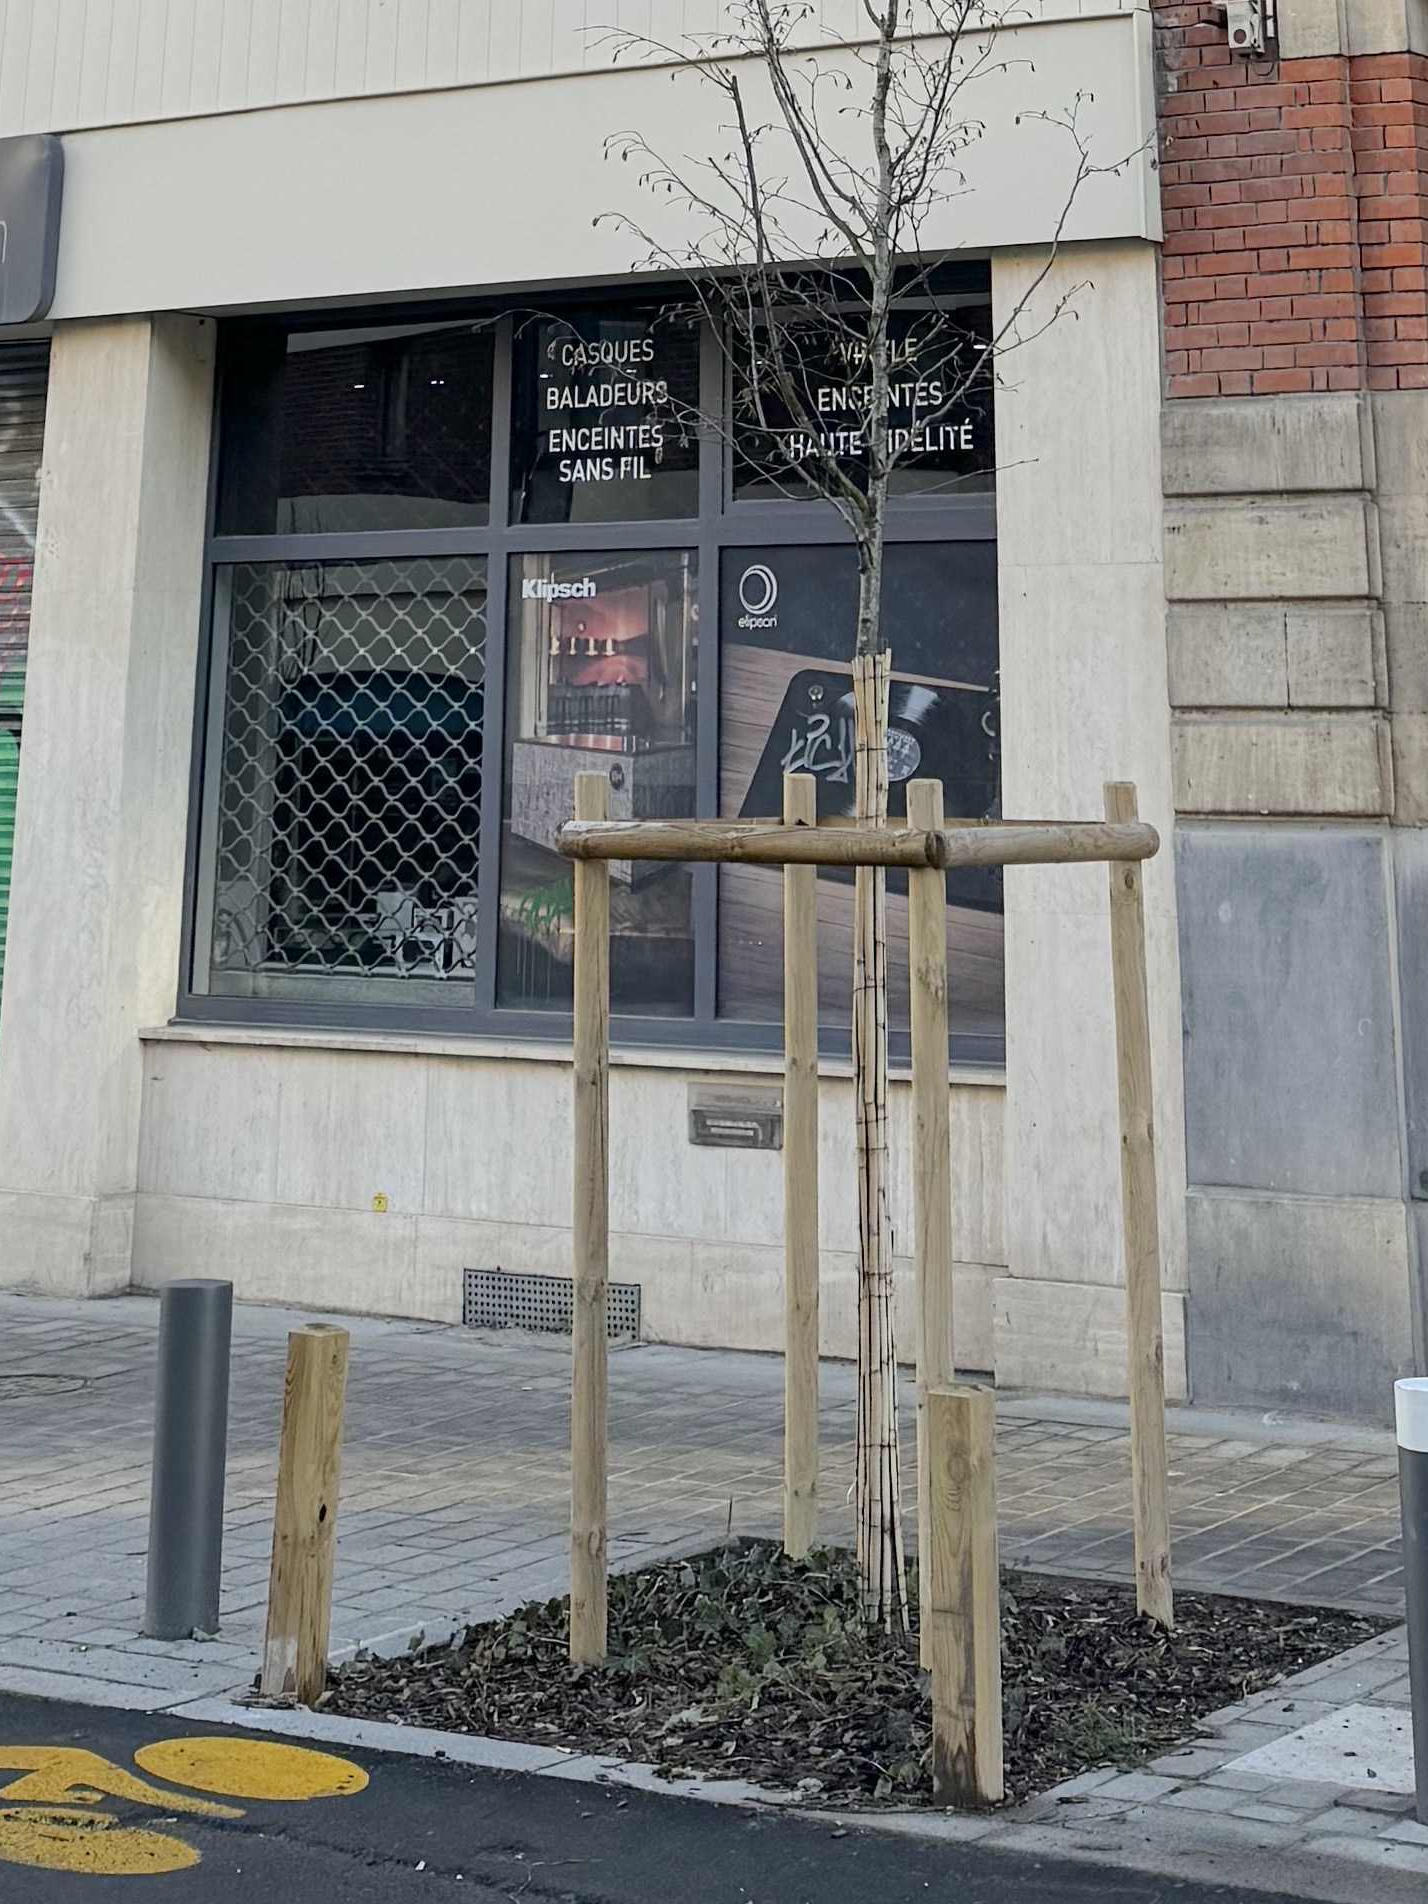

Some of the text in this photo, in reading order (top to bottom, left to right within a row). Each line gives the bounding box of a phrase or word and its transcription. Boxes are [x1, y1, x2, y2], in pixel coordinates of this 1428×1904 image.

[562, 338, 654, 366] CASQUES
[546, 380, 668, 410] BALADEURS
[549, 424, 664, 453] ENCEINTES
[887, 417, 974, 454] IDÉLITÉ
[559, 455, 652, 482] SANS FIL
[521, 577, 597, 603] Klipsch
